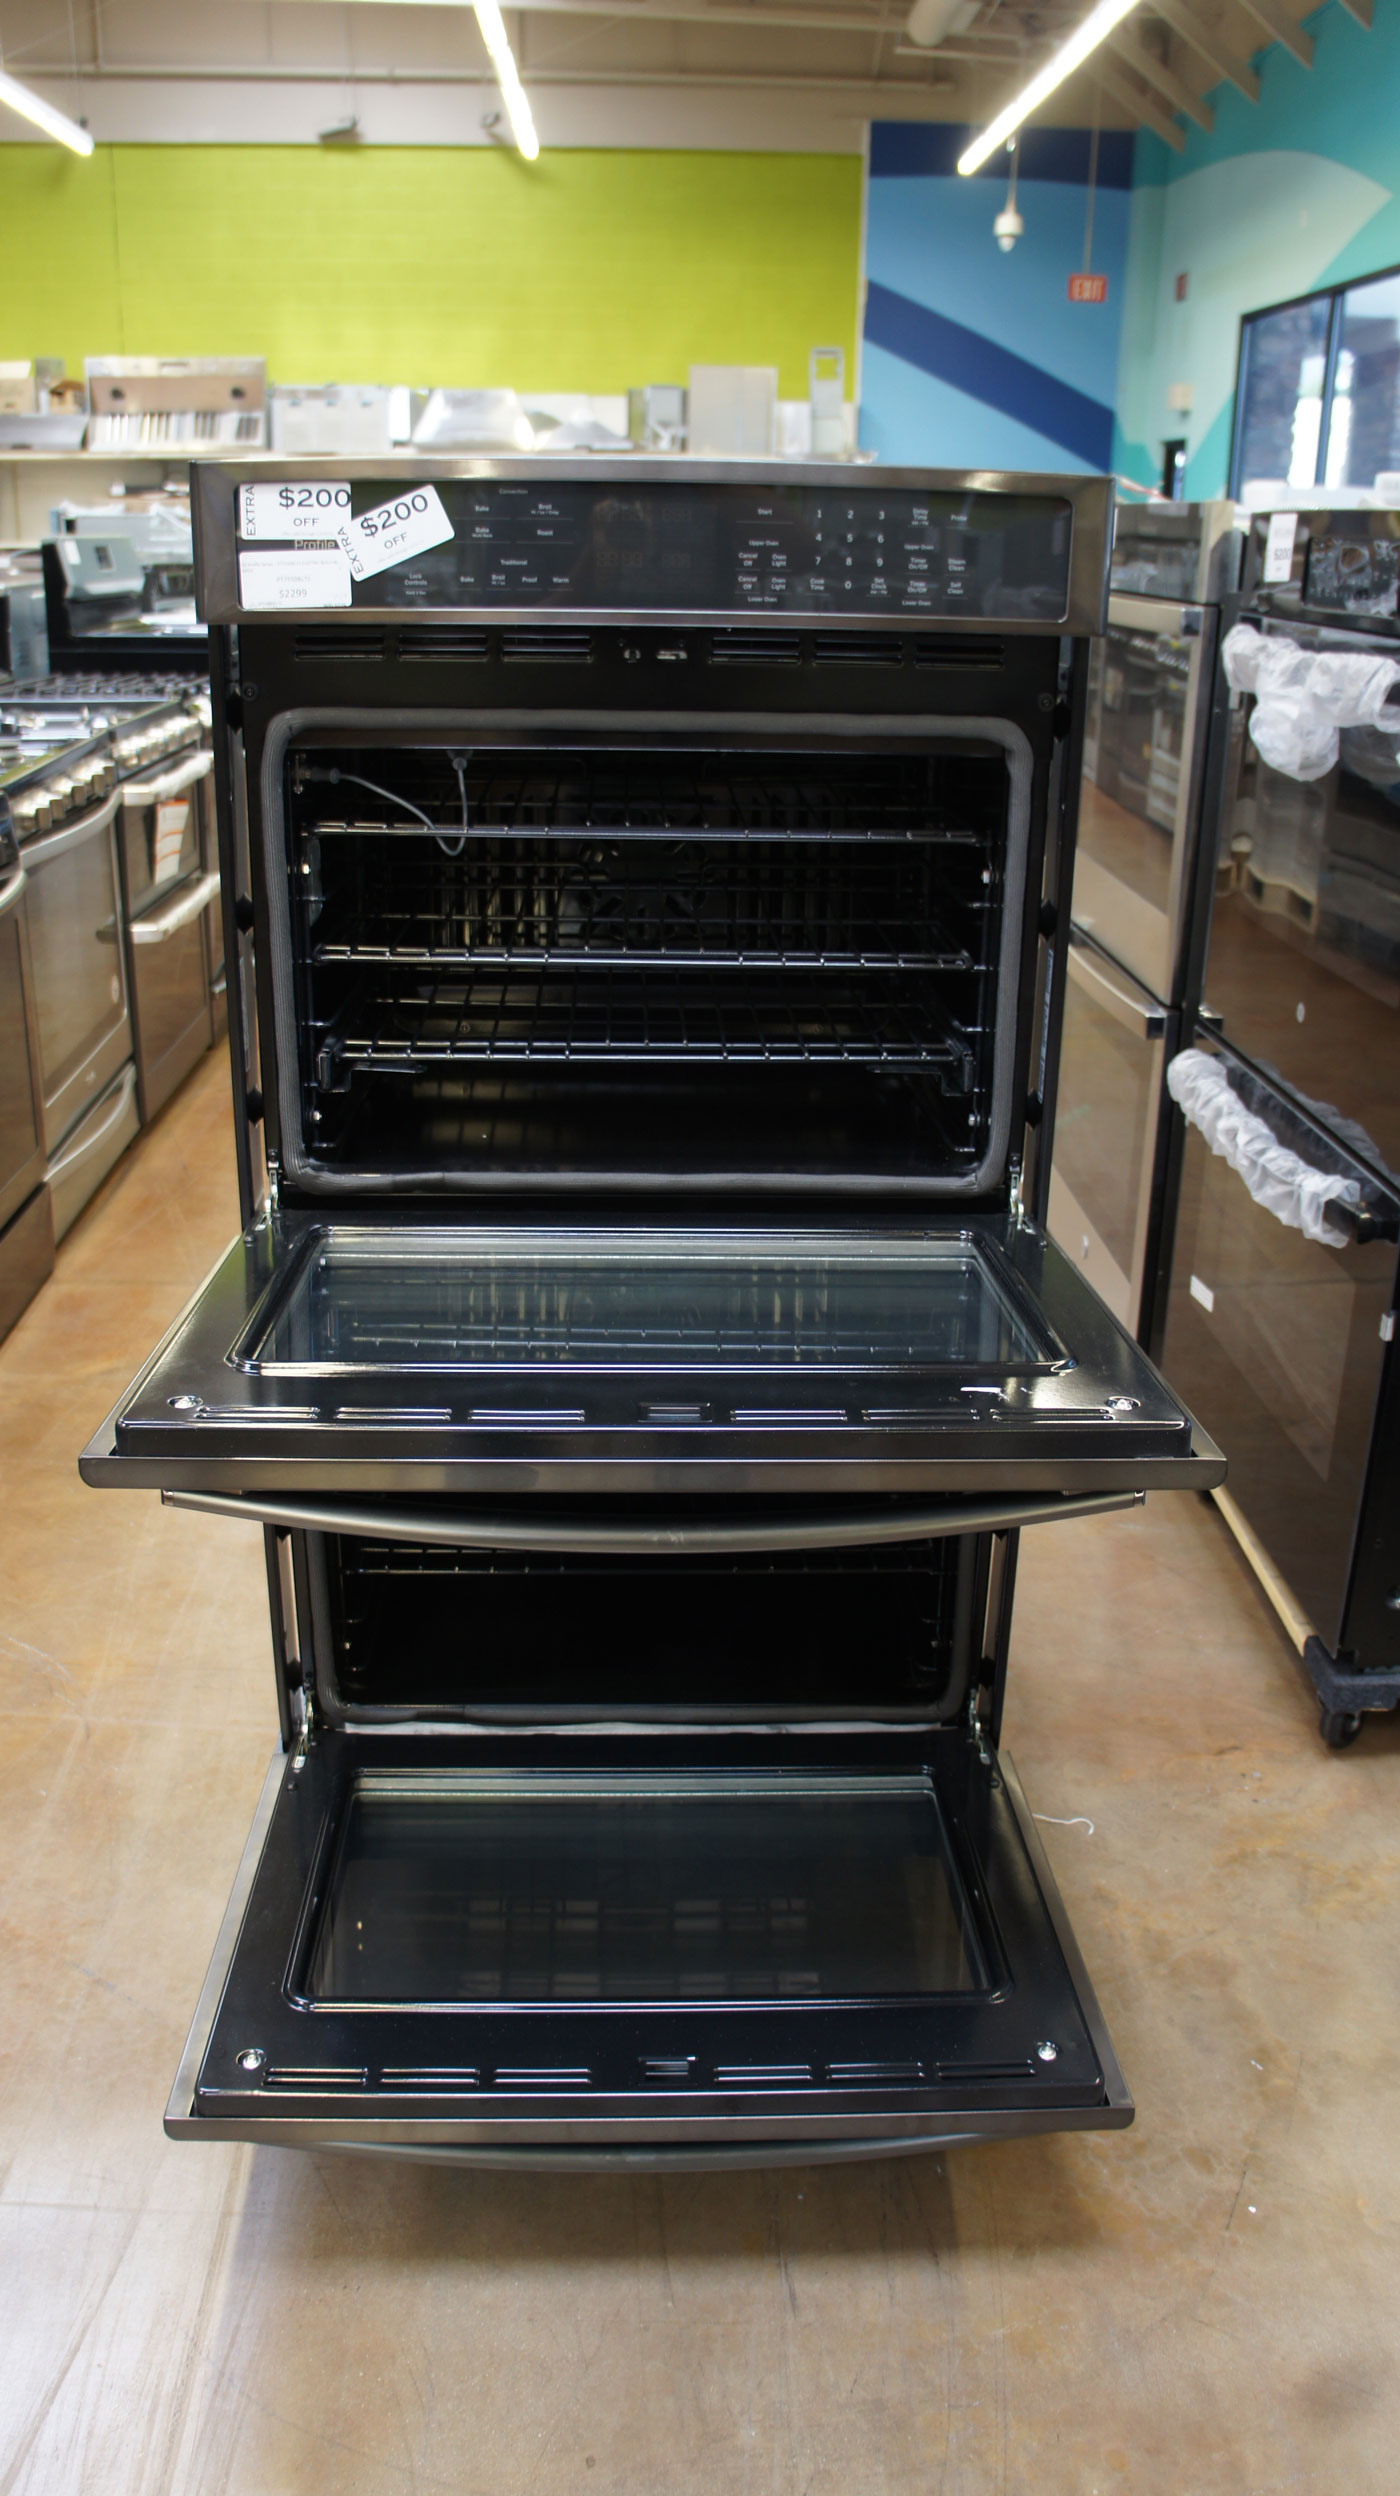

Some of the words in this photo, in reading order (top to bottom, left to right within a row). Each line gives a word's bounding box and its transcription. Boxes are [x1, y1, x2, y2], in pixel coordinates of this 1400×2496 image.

[278, 487, 351, 509] $200
[246, 485, 256, 536] EXTRA
[757, 508, 772, 516] Start
[817, 509, 822, 519] 1
[847, 510, 854, 519] 2
[879, 510, 885, 520] 3
[360, 494, 429, 538] $200
[293, 517, 319, 527] OFF
[475, 526, 490, 534] Bake
[537, 529, 554, 537] Roast
[384, 532, 408, 549] OFF
[815, 533, 822, 542] 4
[847, 533, 853, 543] 5
[877, 534, 884, 543] 6
[294, 539, 335, 549] Profile
[337, 527, 364, 574] EXTRA
[815, 556, 821, 566] 7
[845, 557, 852, 566] 8
[876, 557, 883, 567] 9
[552, 576, 569, 584] Warm
[844, 580, 852, 590] 0
